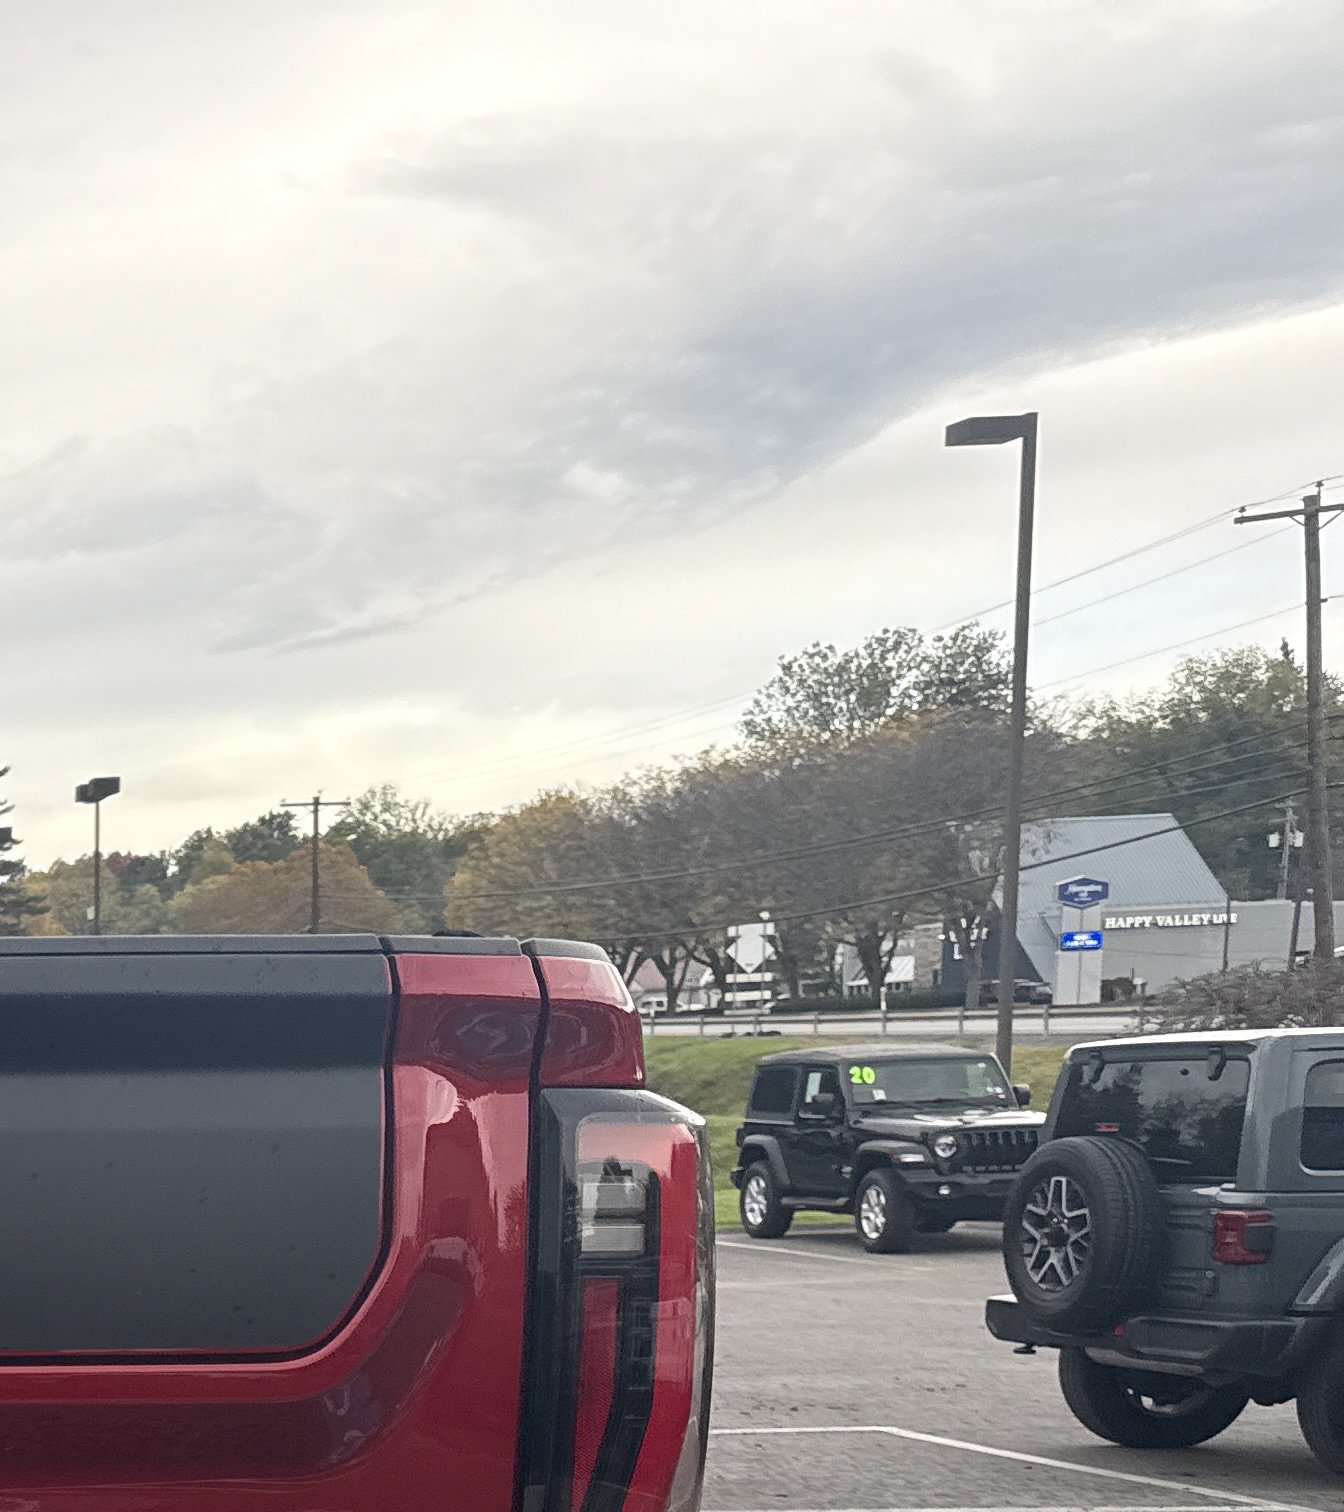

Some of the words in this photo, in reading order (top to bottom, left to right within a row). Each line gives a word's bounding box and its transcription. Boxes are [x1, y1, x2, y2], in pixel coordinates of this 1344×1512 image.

[1104, 915, 1154, 929] HAPPY
[1156, 913, 1210, 927] VALLEY
[849, 1066, 875, 1084] 20
